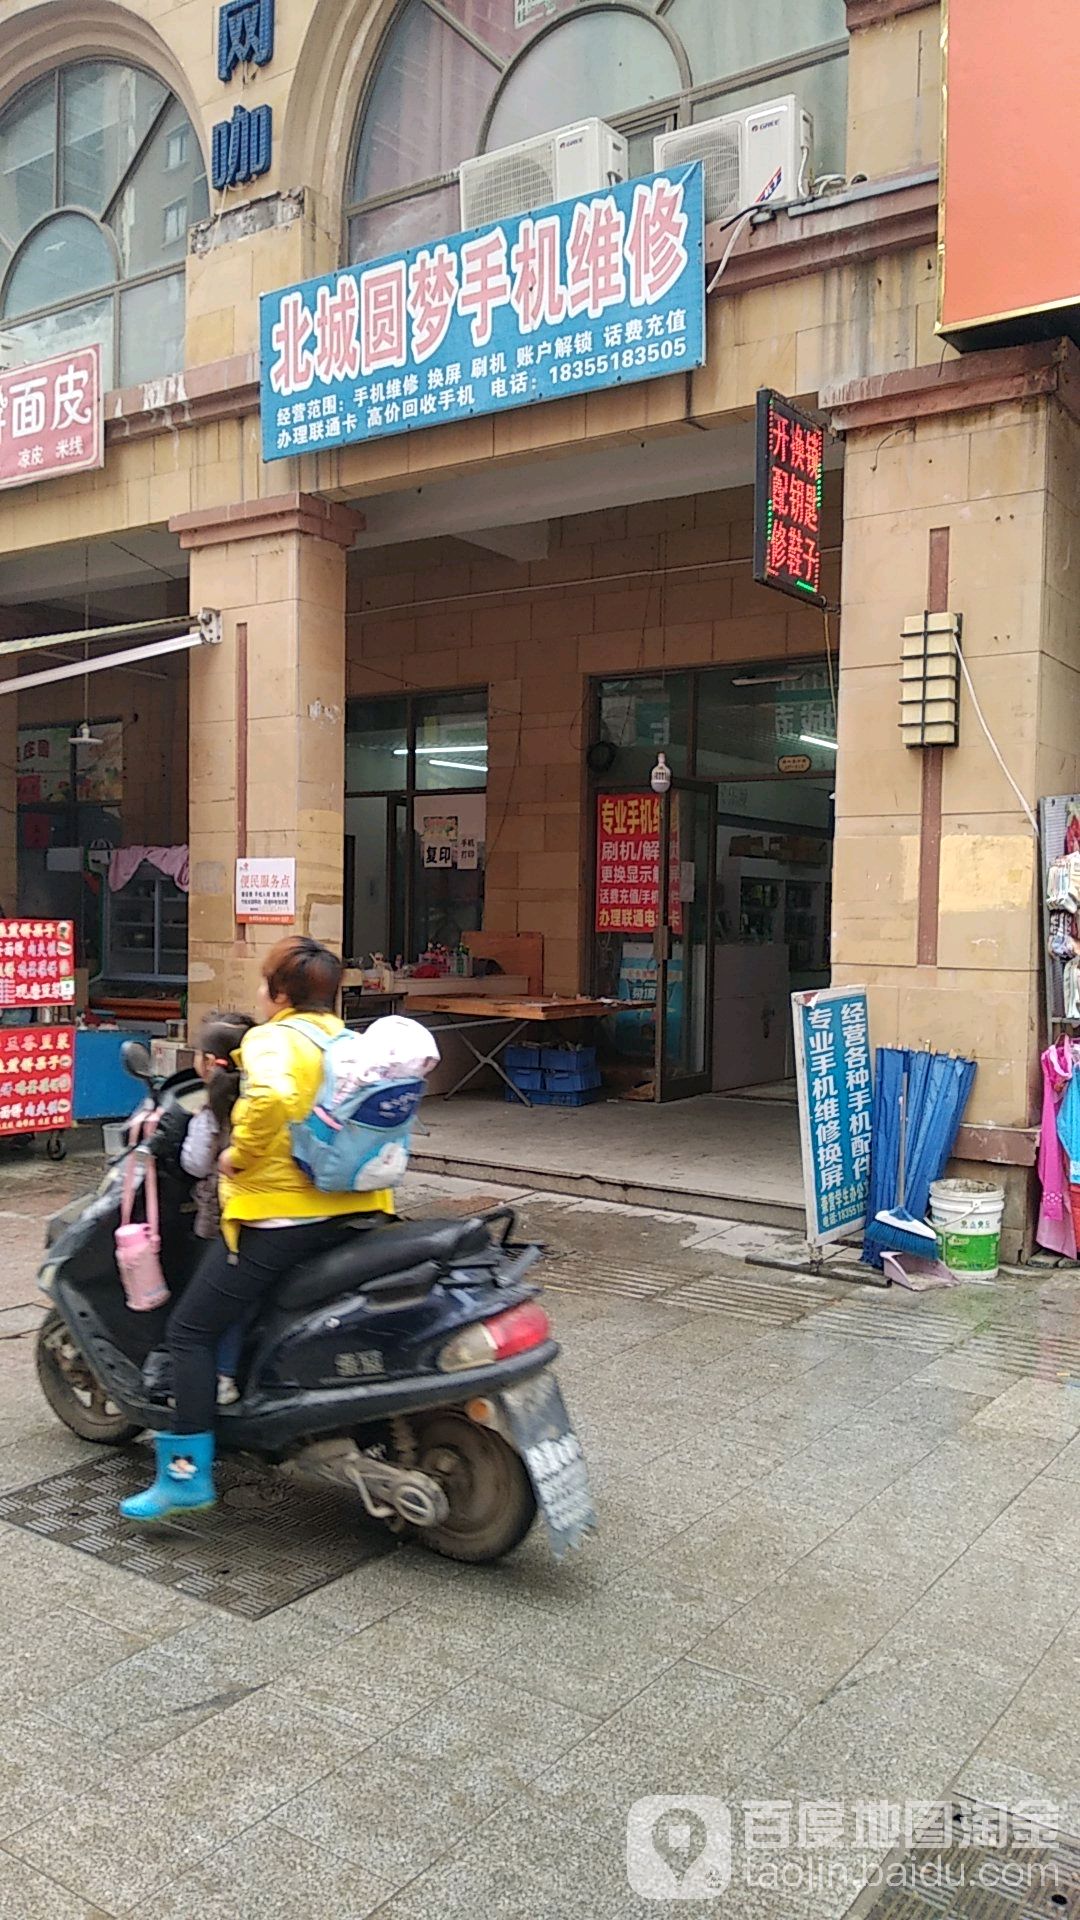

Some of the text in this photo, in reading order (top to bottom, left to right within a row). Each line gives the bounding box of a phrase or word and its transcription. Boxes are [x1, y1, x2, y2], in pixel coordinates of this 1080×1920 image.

[272, 179, 688, 396] 北城圆梦手机维修
[276, 413, 358, 449] 办理联通卡
[366, 386, 475, 429] 高价回收手机
[548, 336, 687, 385] 18355183505
[352, 373, 420, 406] 手机维修
[427, 362, 462, 391] 换屏
[470, 354, 507, 380] 刷机
[516, 330, 594, 368] 账户解锁
[602, 308, 688, 347] 话费充值
[55, 435, 84, 459] 米线
[240, 873, 291, 889] 便民服务点
[426, 846, 450, 863] 复印
[807, 1008, 844, 1193] 专业手机维修换屏
[841, 1001, 872, 1180] 经营各种手机配件
